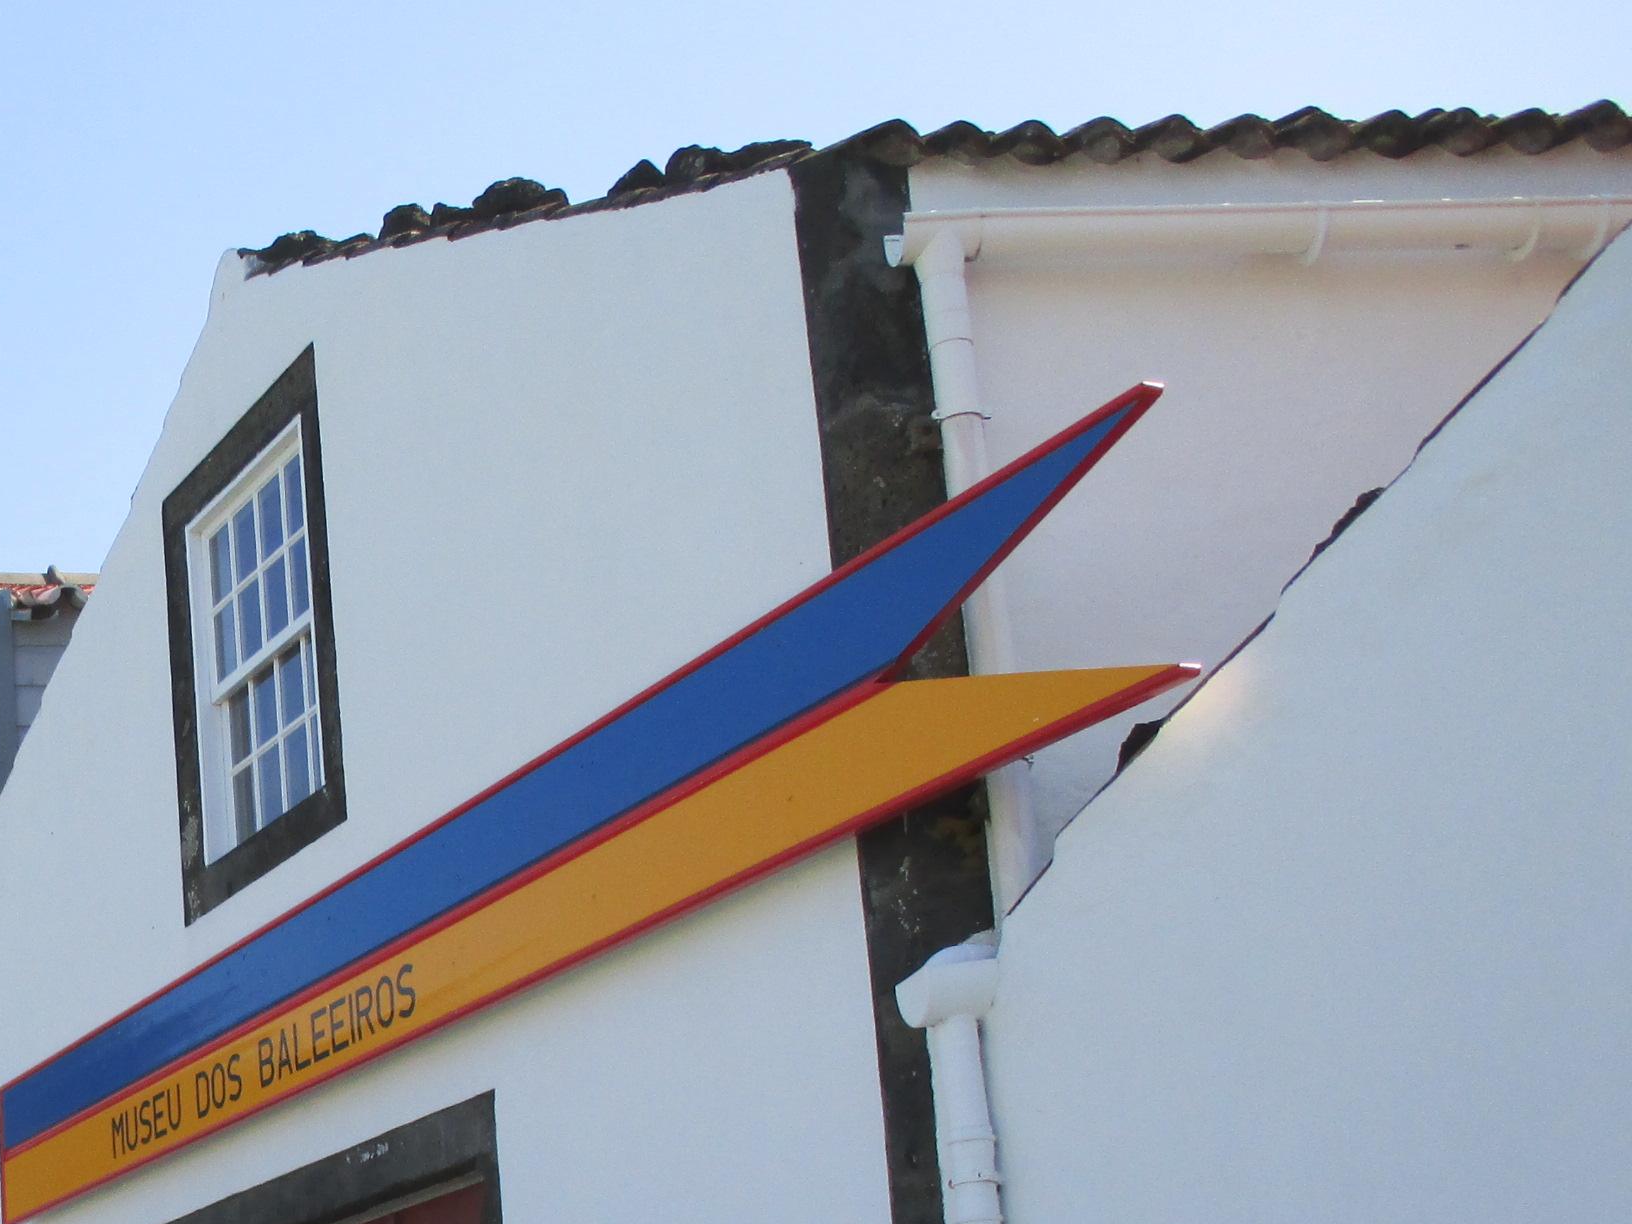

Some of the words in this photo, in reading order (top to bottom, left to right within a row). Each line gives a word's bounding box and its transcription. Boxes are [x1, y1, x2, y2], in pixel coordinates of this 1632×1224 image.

[111, 1084, 181, 1159] MUSEU
[195, 1054, 243, 1119] DOS
[258, 964, 416, 1088] BALEEIROS
